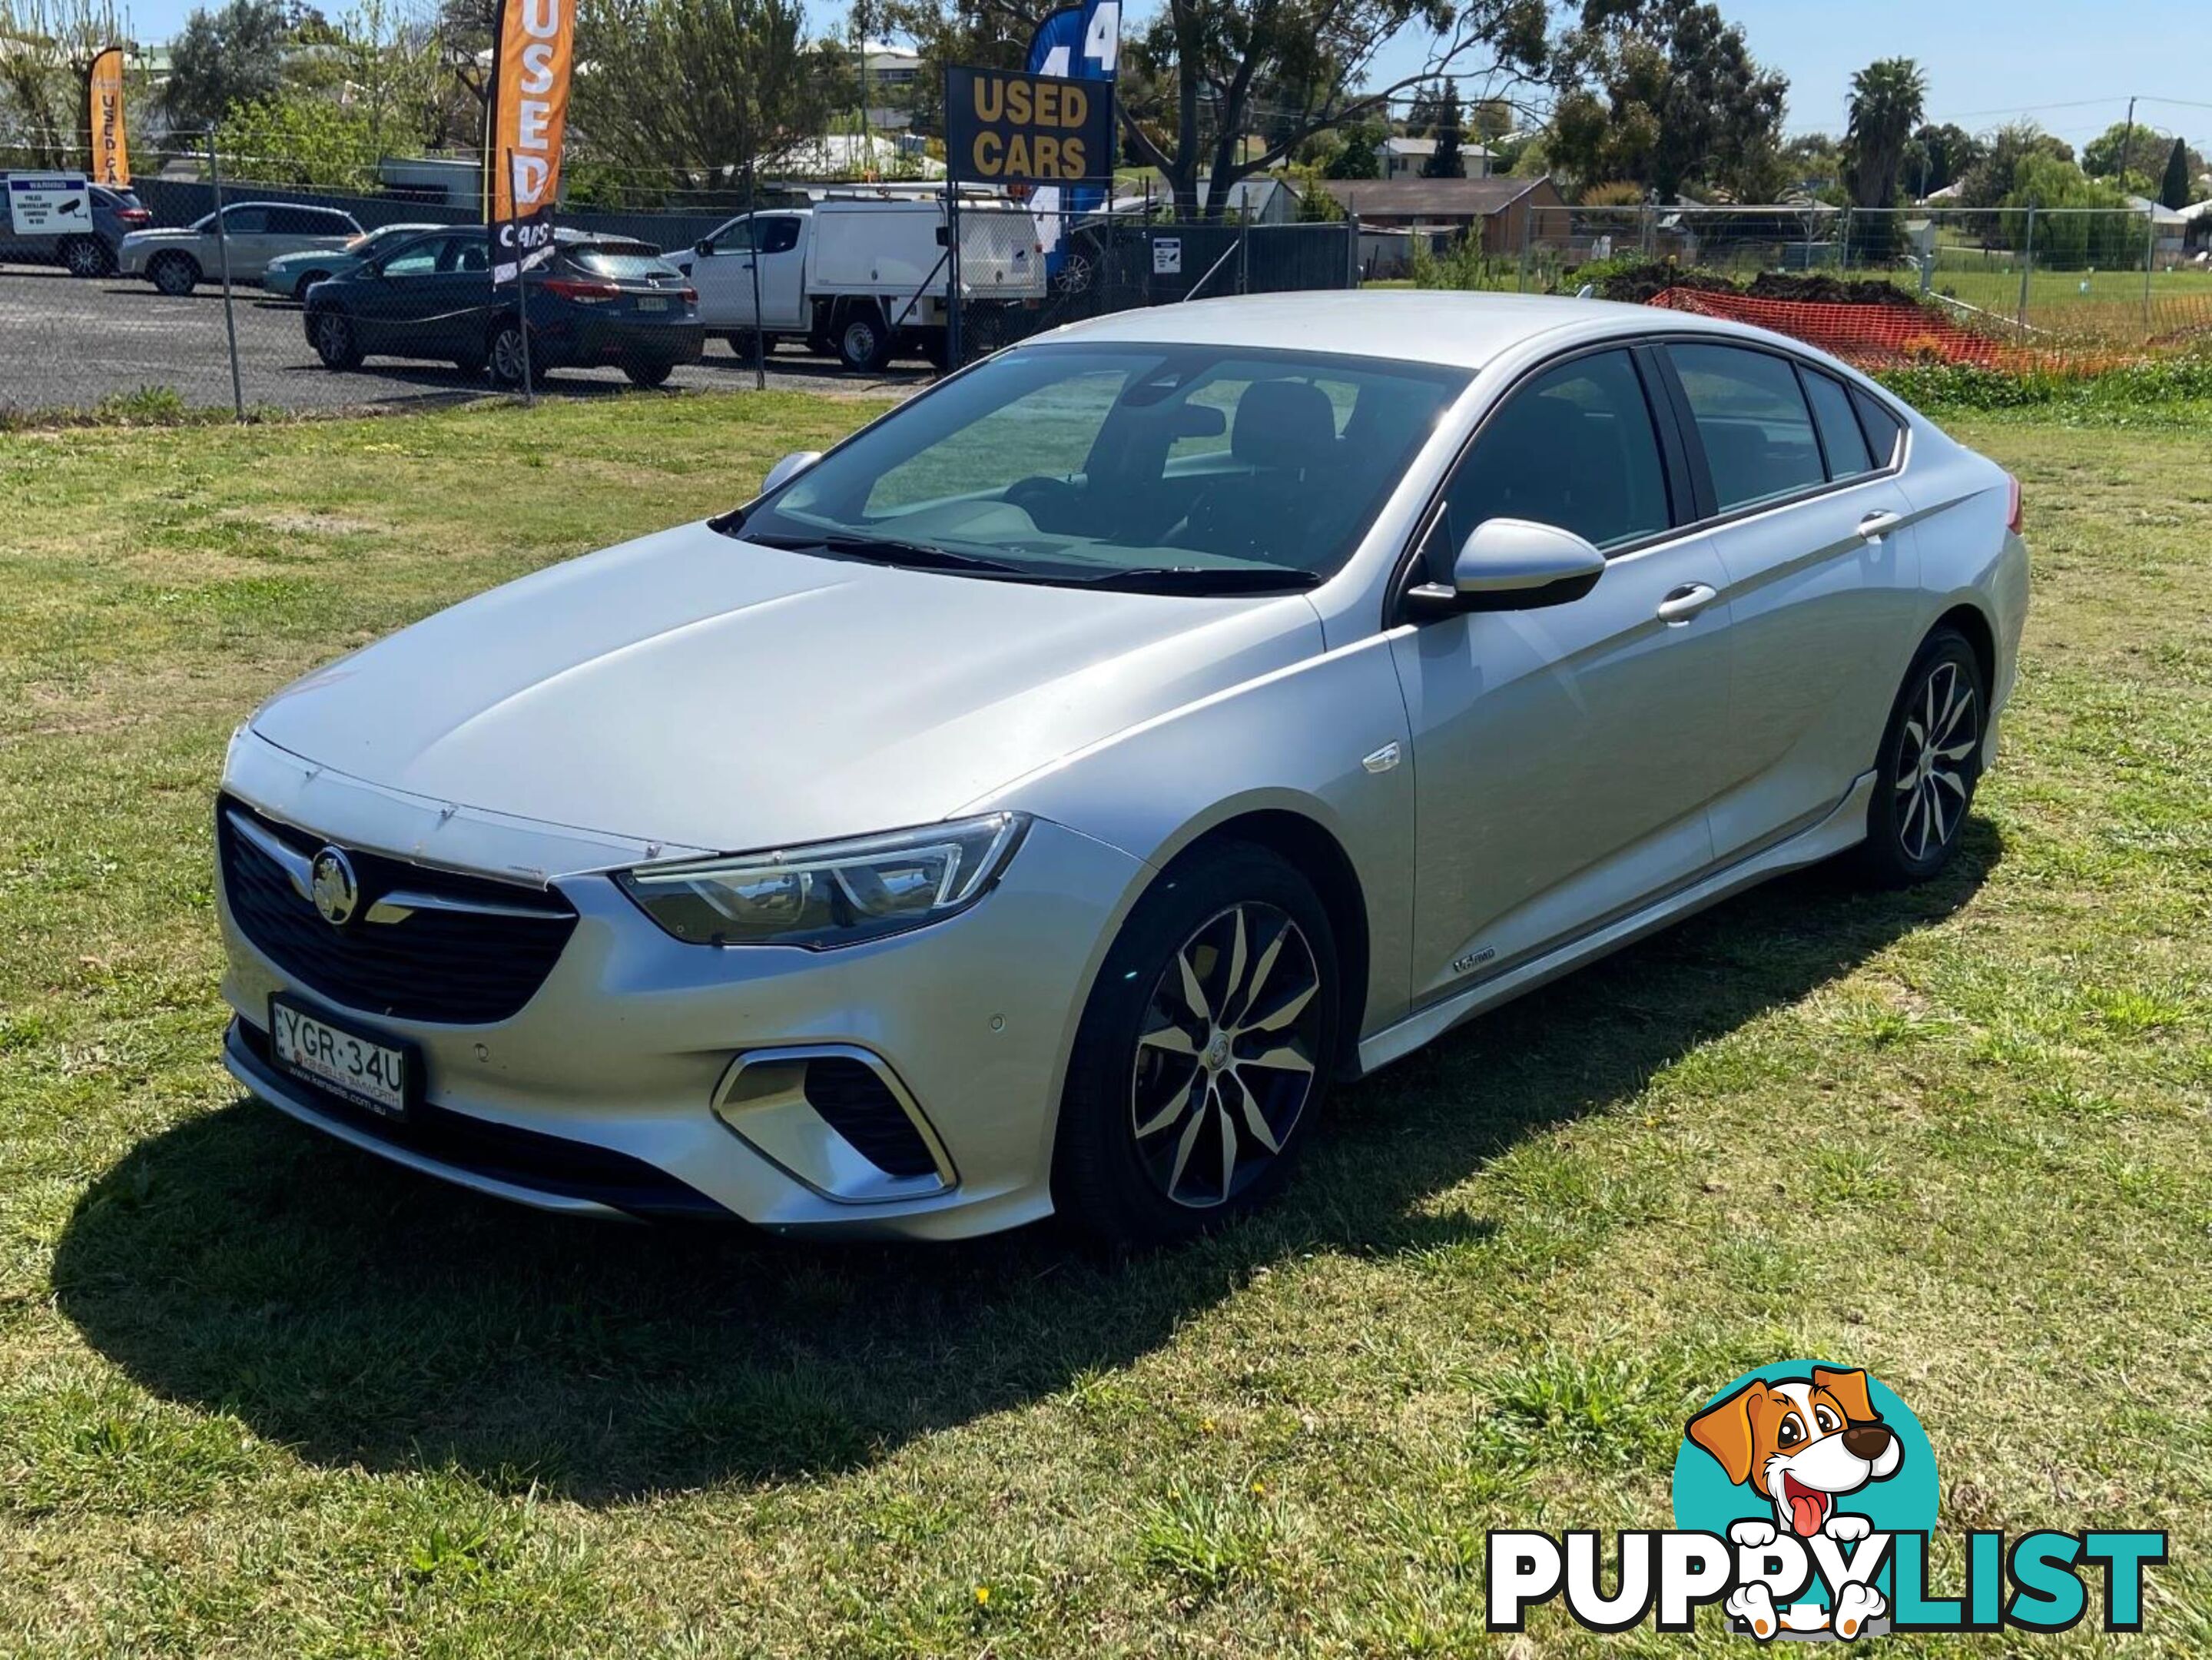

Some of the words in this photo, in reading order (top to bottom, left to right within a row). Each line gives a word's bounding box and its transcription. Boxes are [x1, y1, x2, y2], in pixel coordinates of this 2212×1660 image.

[102, 95, 116, 151] USED
[512, 0, 559, 203] USED
[974, 77, 1087, 128] USED
[973, 131, 1086, 180] CARS
[29, 181, 67, 190] WARNING
[500, 223, 549, 247] CARS
